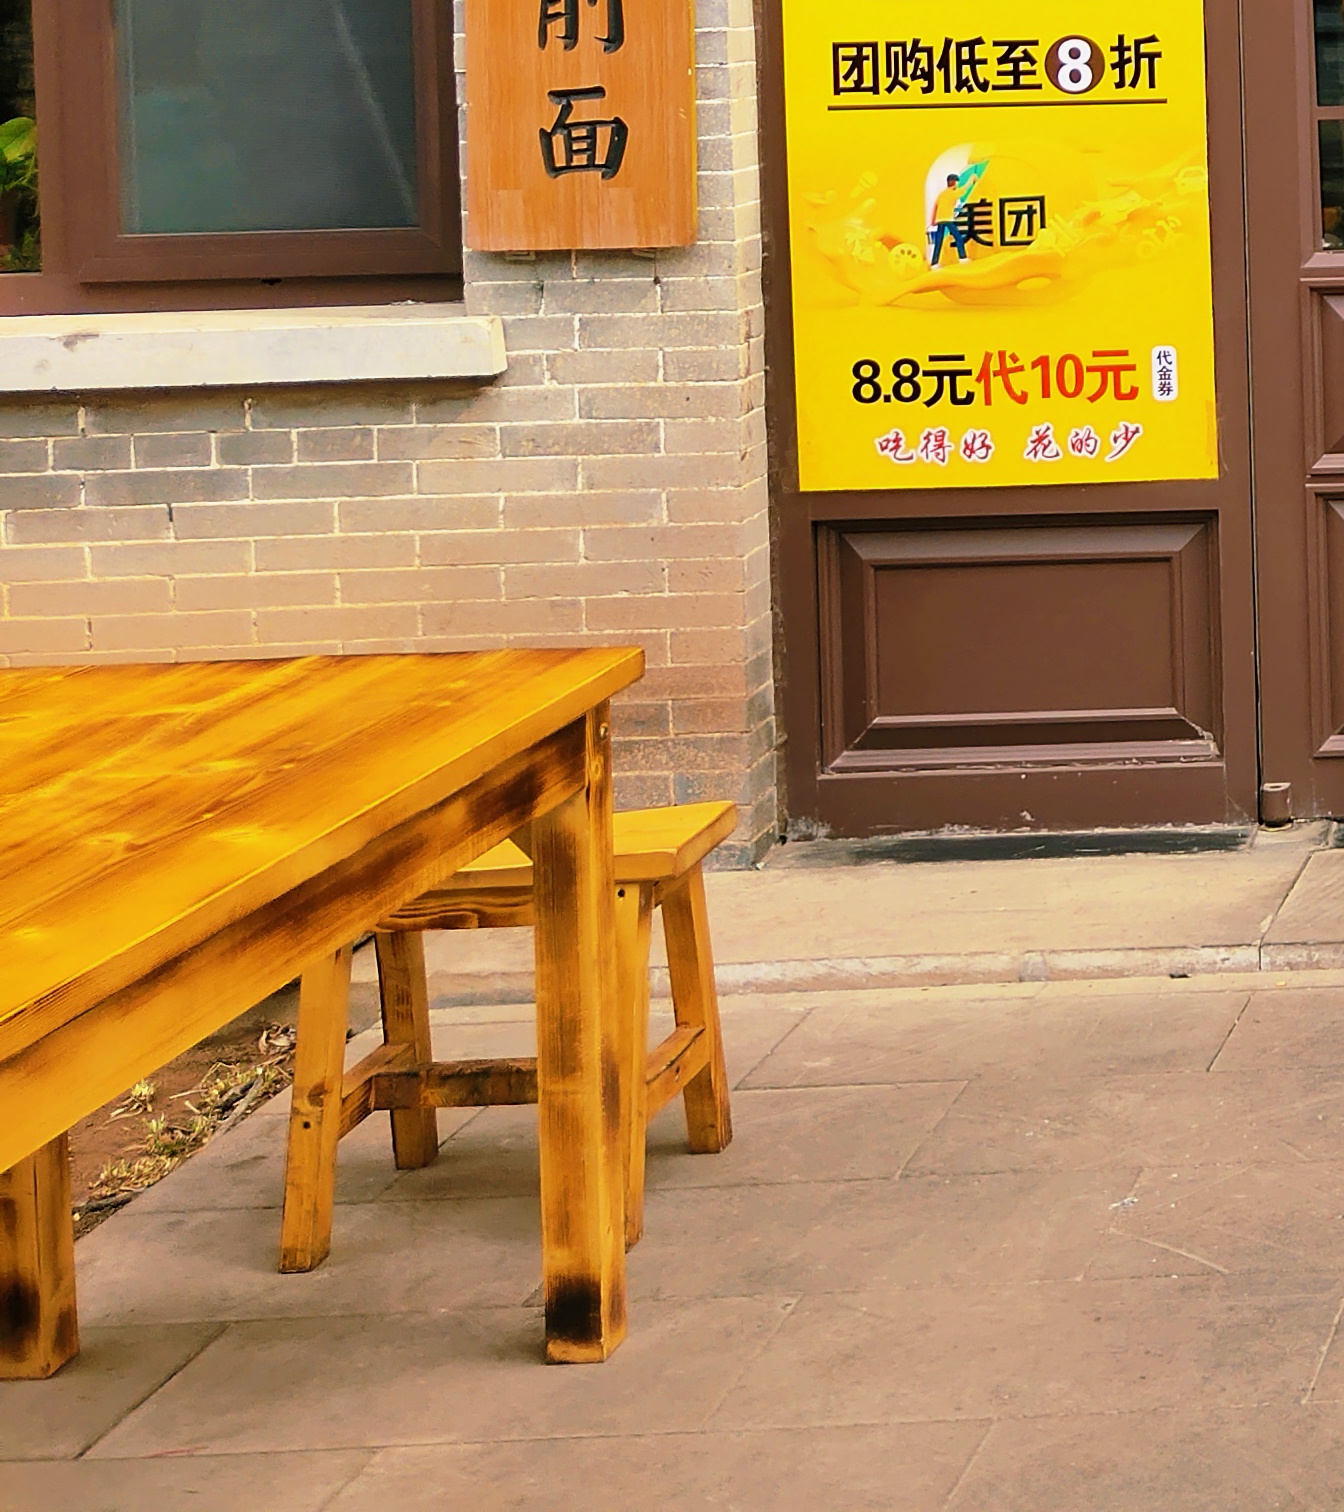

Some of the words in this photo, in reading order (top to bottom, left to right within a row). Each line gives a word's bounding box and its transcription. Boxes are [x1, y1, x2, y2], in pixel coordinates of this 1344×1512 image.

[831, 34, 1163, 96] 团购低至8折
[950, 195, 1046, 247] 美团
[851, 348, 1140, 408] 8.8元代10元
[1155, 350, 1174, 397] 代金券
[876, 429, 993, 464] 吃得好
[1024, 422, 1143, 461] 花的少
